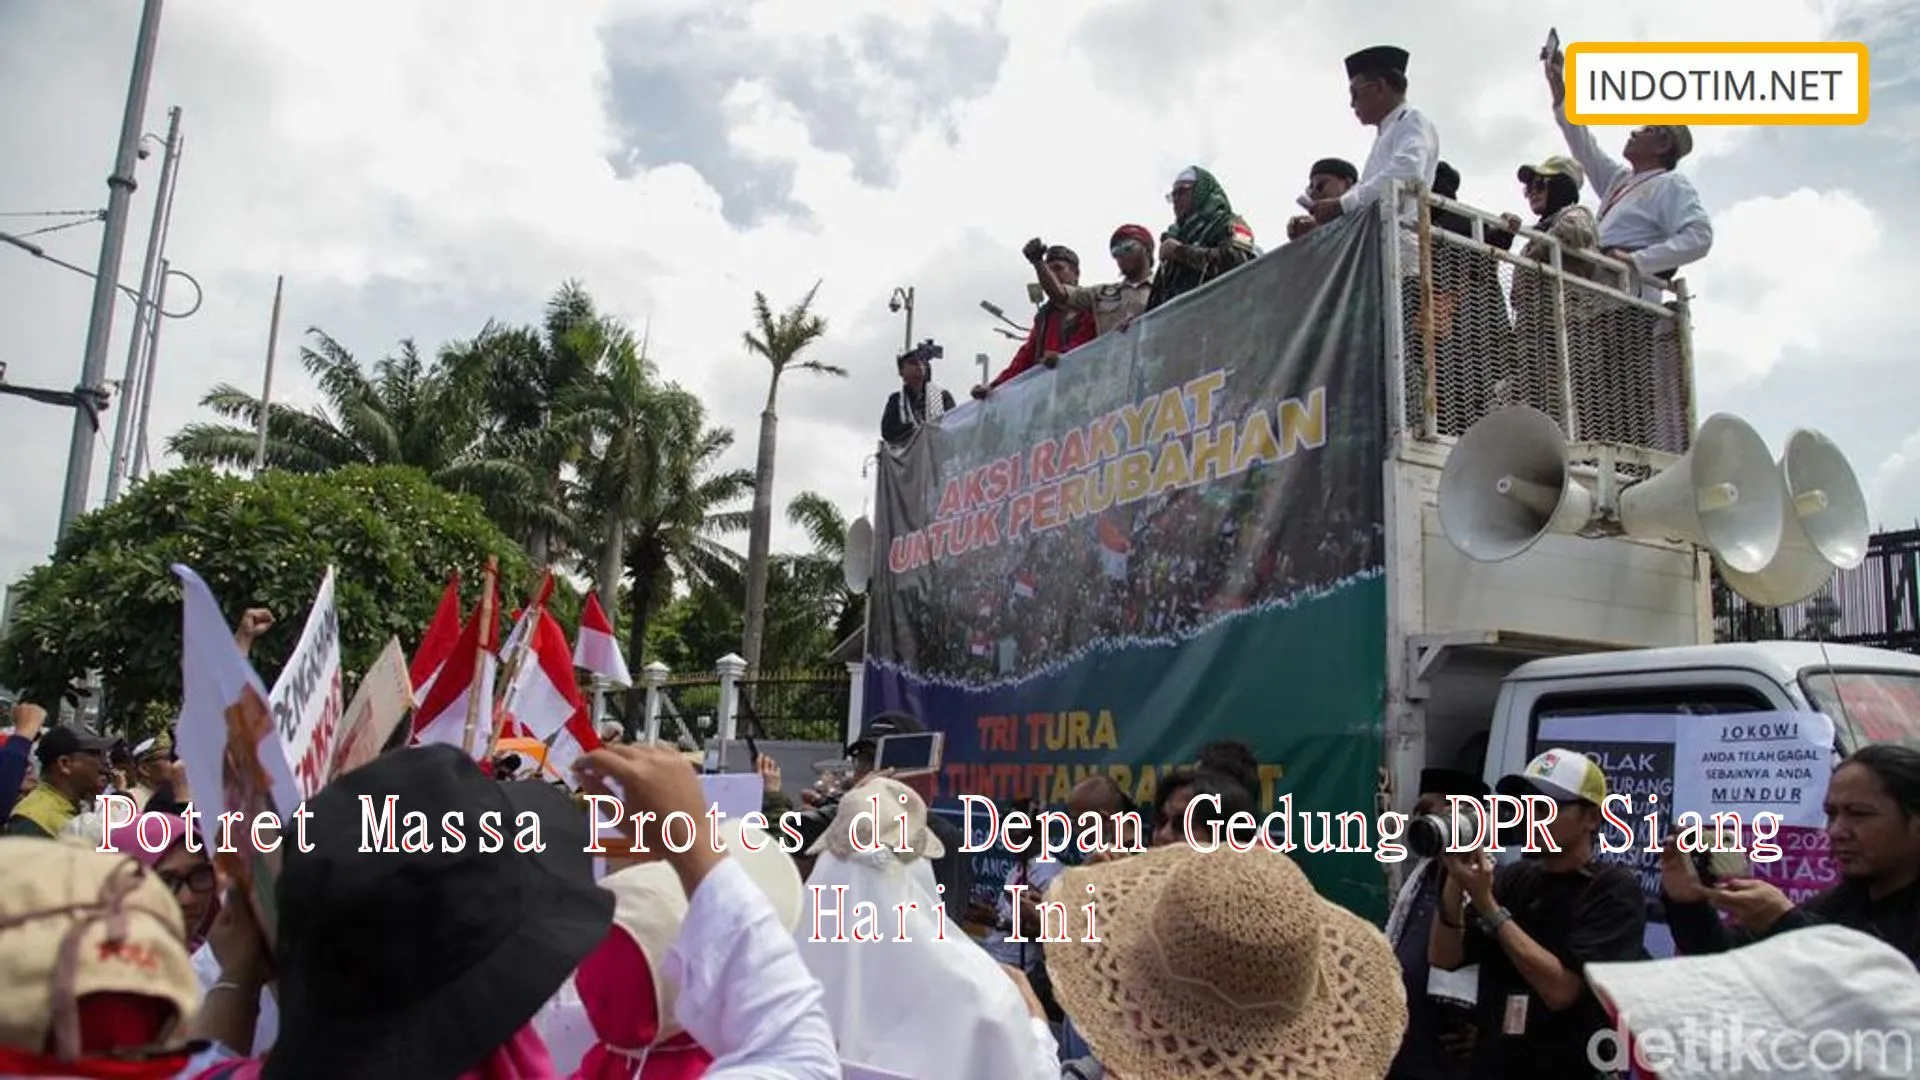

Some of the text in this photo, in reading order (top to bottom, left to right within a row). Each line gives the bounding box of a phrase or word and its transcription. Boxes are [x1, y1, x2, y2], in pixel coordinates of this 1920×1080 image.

[936, 368, 1227, 520] AKSI RAKYAT
[888, 386, 1328, 574] UNTUK PERUBAHAN
[977, 709, 1118, 750] TRI TURA
[1721, 722, 1799, 740] JOKOWI
[1585, 752, 1655, 771] OLAK
[1702, 749, 1820, 763] ANDA TELAH GAGAL
[1706, 768, 1812, 780] SEBAIKNYA ANDA
[1711, 787, 1802, 801] MUNDUR
